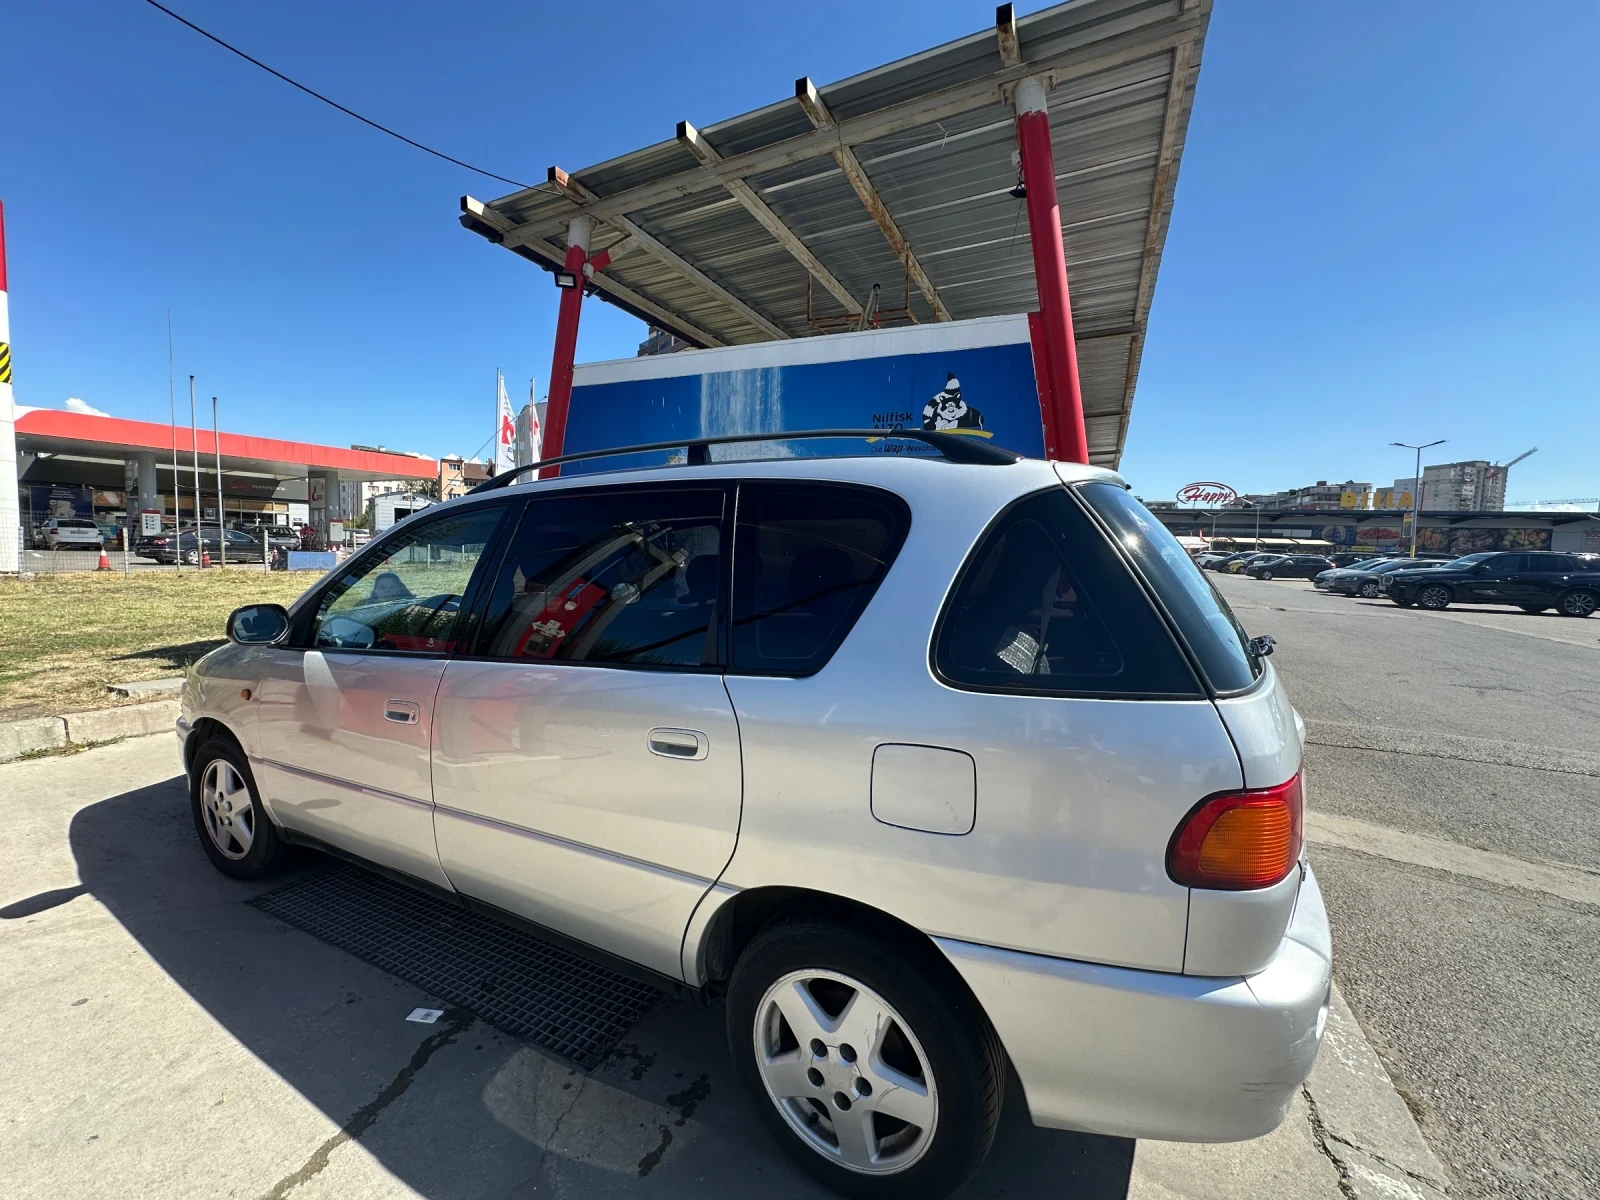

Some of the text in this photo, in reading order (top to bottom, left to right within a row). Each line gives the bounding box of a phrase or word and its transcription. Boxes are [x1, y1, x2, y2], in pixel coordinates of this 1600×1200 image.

[872, 411, 914, 423] Nilfisk
[1183, 486, 1233, 504] Happy
[1340, 491, 1414, 508] BILLA
